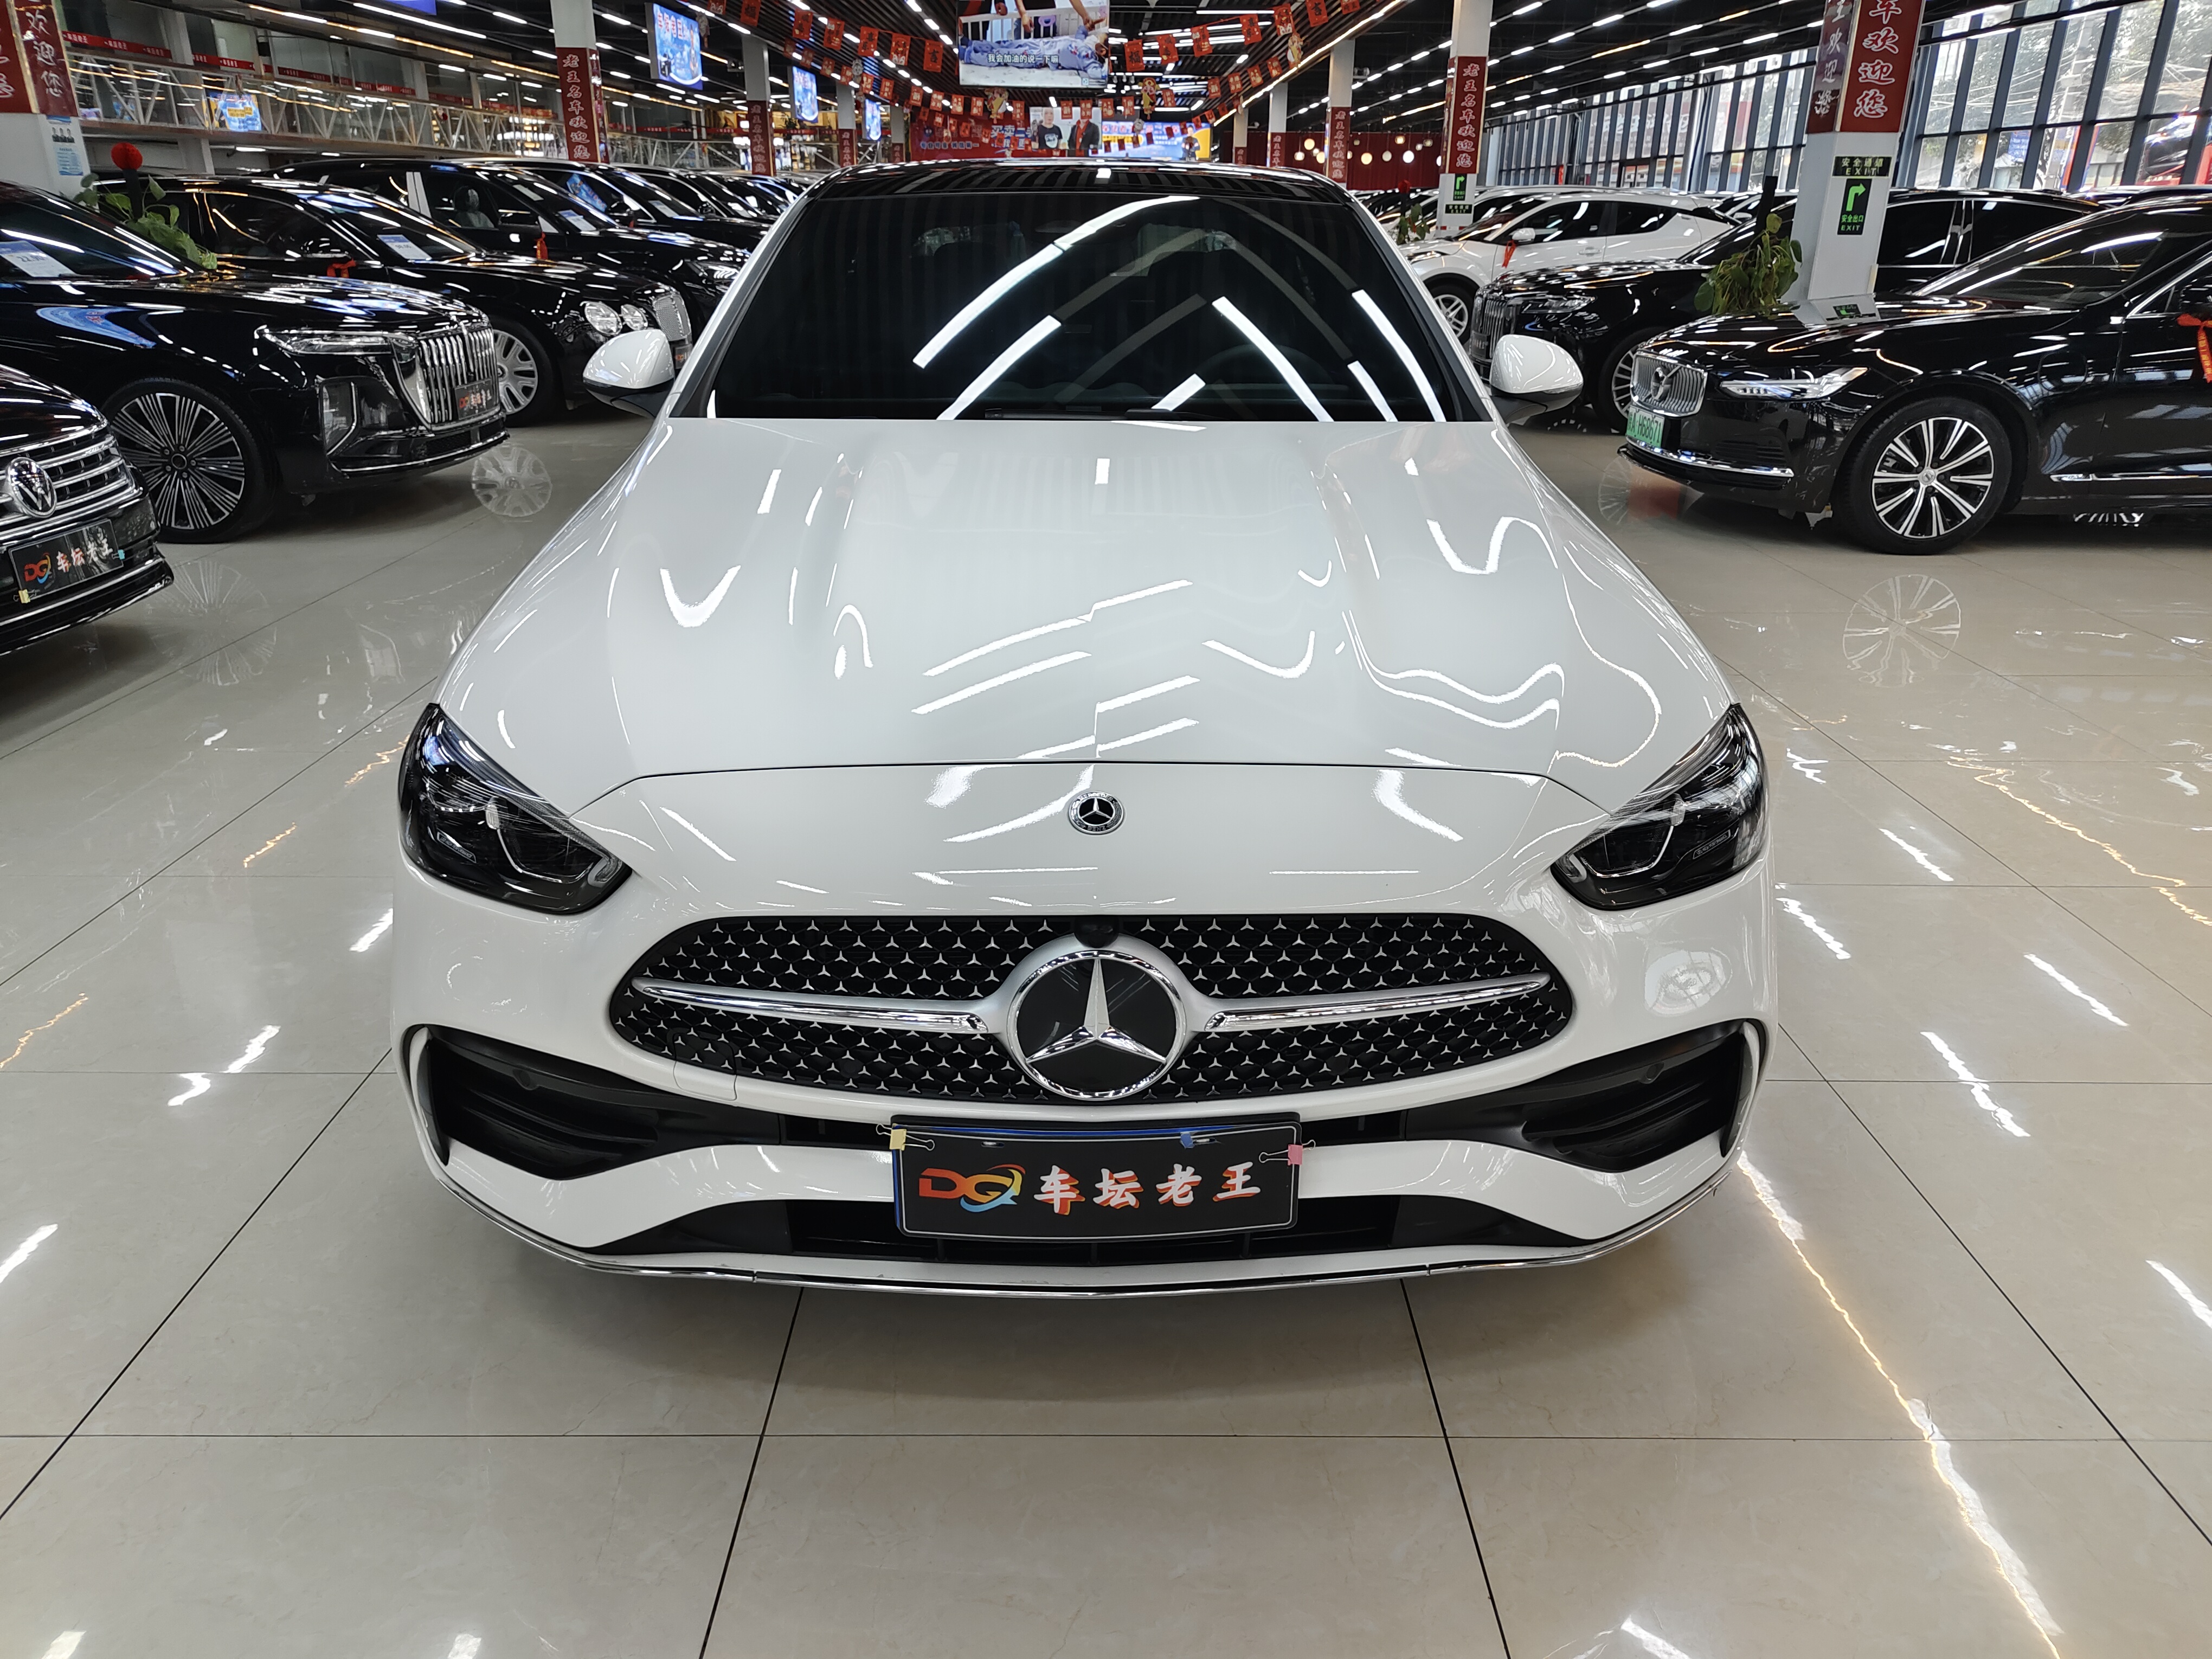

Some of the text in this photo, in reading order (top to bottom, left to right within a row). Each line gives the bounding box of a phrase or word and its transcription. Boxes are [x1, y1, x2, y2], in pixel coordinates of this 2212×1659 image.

[25, 0, 63, 98] 欢迎您
[987, 54, 1059, 63] 我会加油的说一下嘛
[563, 54, 591, 159] 老王名车欢迎您
[1456, 63, 1480, 168] 老王名车欢迎您
[1842, 214, 1864, 223] 安全出口
[918, 1161, 1261, 1216] DG 车坛老王
